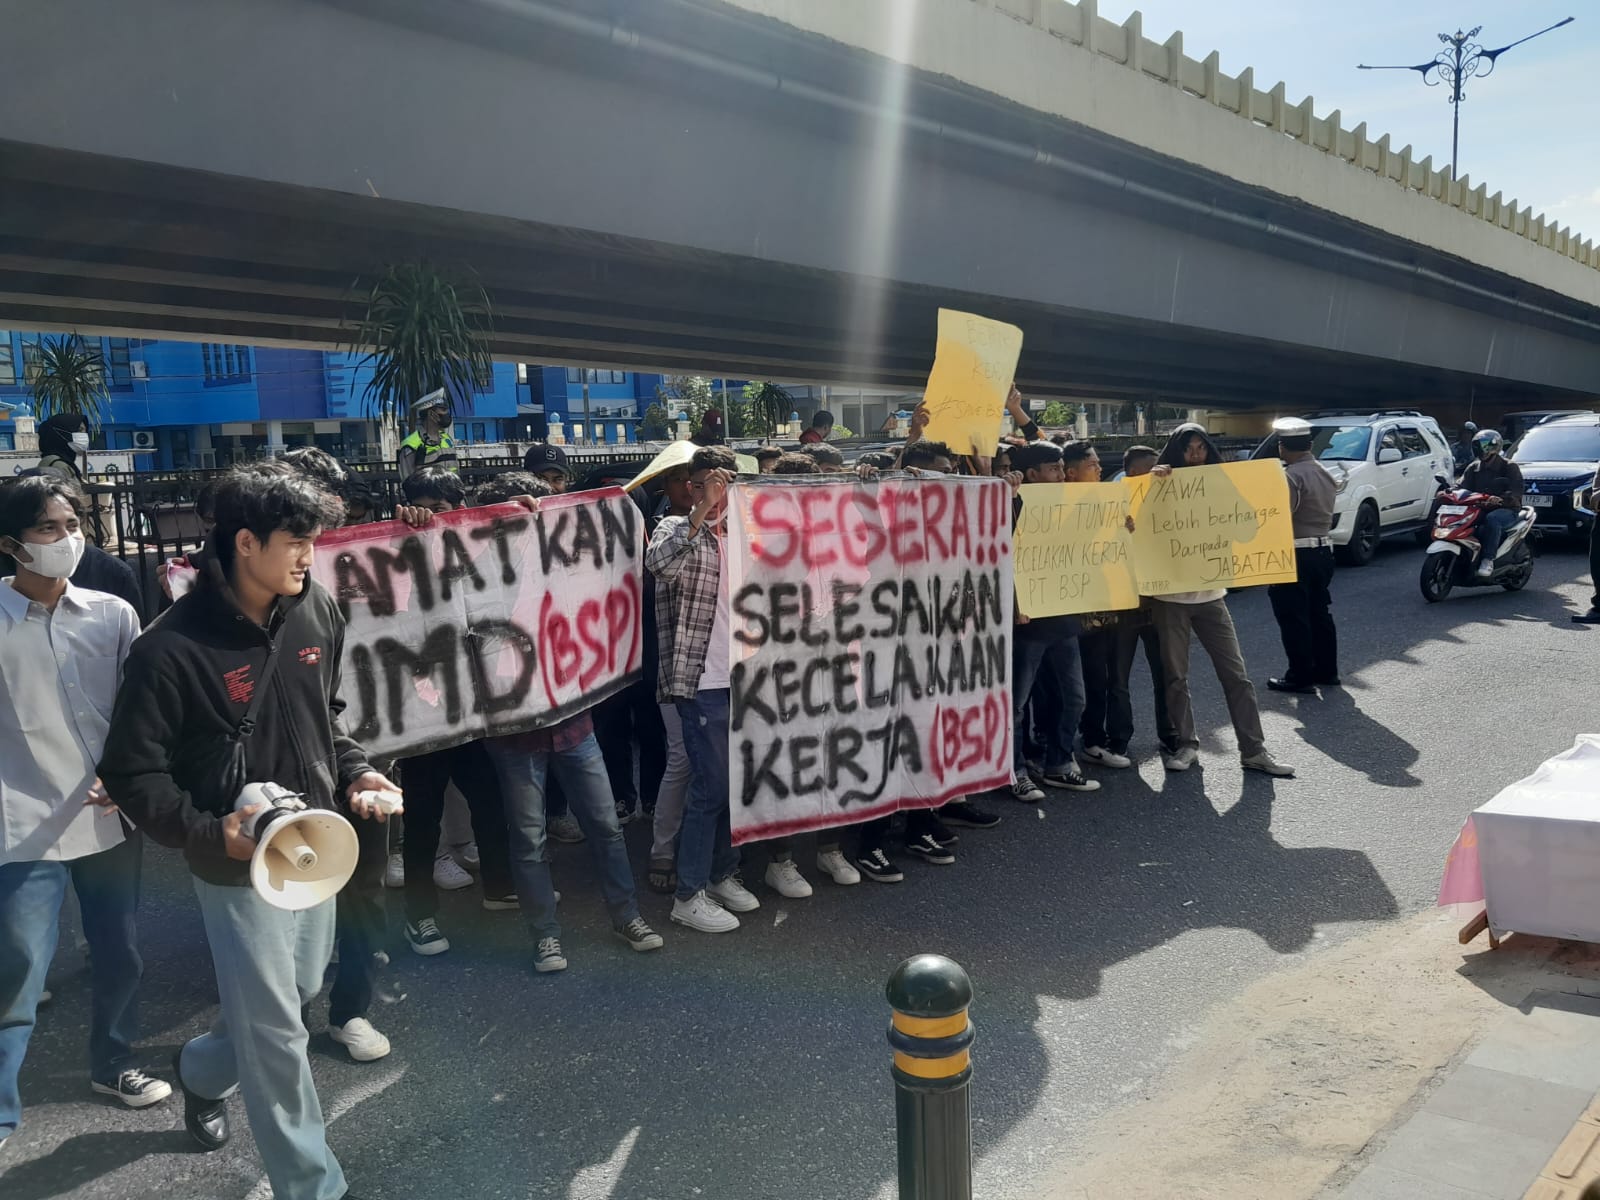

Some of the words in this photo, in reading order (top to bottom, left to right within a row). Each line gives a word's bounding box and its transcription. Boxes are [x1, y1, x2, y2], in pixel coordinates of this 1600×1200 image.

[545, 449, 557, 461] S
[751, 481, 1009, 568] SEGERA!!!
[1152, 509, 1200, 535] Lebih
[1208, 503, 1280, 530] berharga
[1081, 540, 1127, 567] KERJA
[1170, 535, 1229, 560] Daripada
[1200, 548, 1294, 582] JABATAN
[733, 569, 1003, 645] SELESAIKAN
[1028, 576, 1047, 608] PT
[1059, 572, 1090, 601] BSP
[538, 572, 639, 709] (BSP)
[730, 634, 1006, 732] KECELAKAAN
[741, 714, 923, 807] KERJA
[929, 688, 1010, 786] (BSP)
